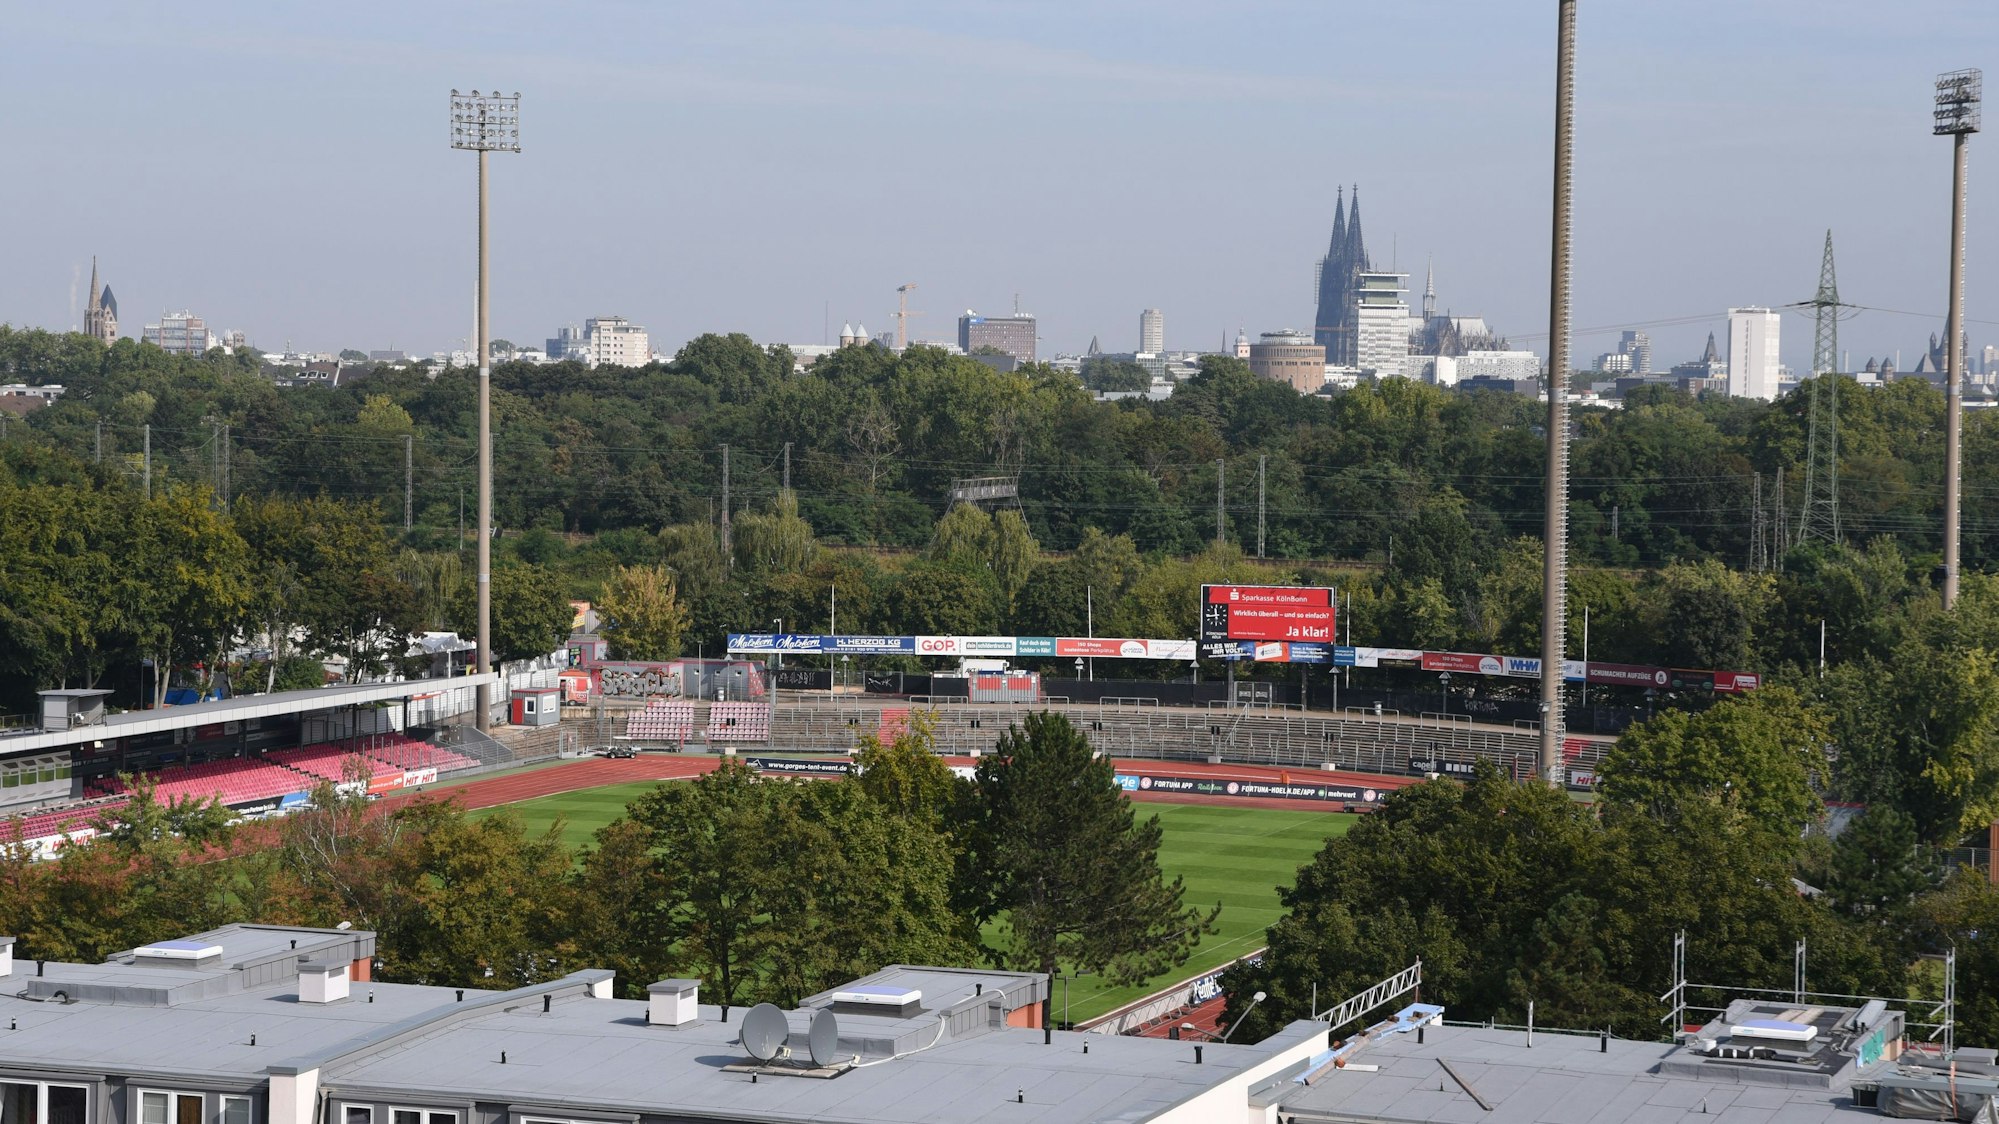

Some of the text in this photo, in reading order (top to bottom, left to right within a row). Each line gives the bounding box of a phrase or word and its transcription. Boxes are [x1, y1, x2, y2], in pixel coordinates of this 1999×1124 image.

[1242, 594, 1308, 603] Sparkasse KölnBonn
[1286, 626, 1329, 637] Ja klar!
[1509, 659, 1540, 672] WHM
[1590, 669, 1652, 680] SCHUMACHER AUFZÜGE
[768, 762, 848, 771] www.gorges-tent-event.de
[406, 776, 419, 786] HIT
[422, 773, 435, 783] HIT
[1153, 780, 1193, 789] FORTUNA APP
